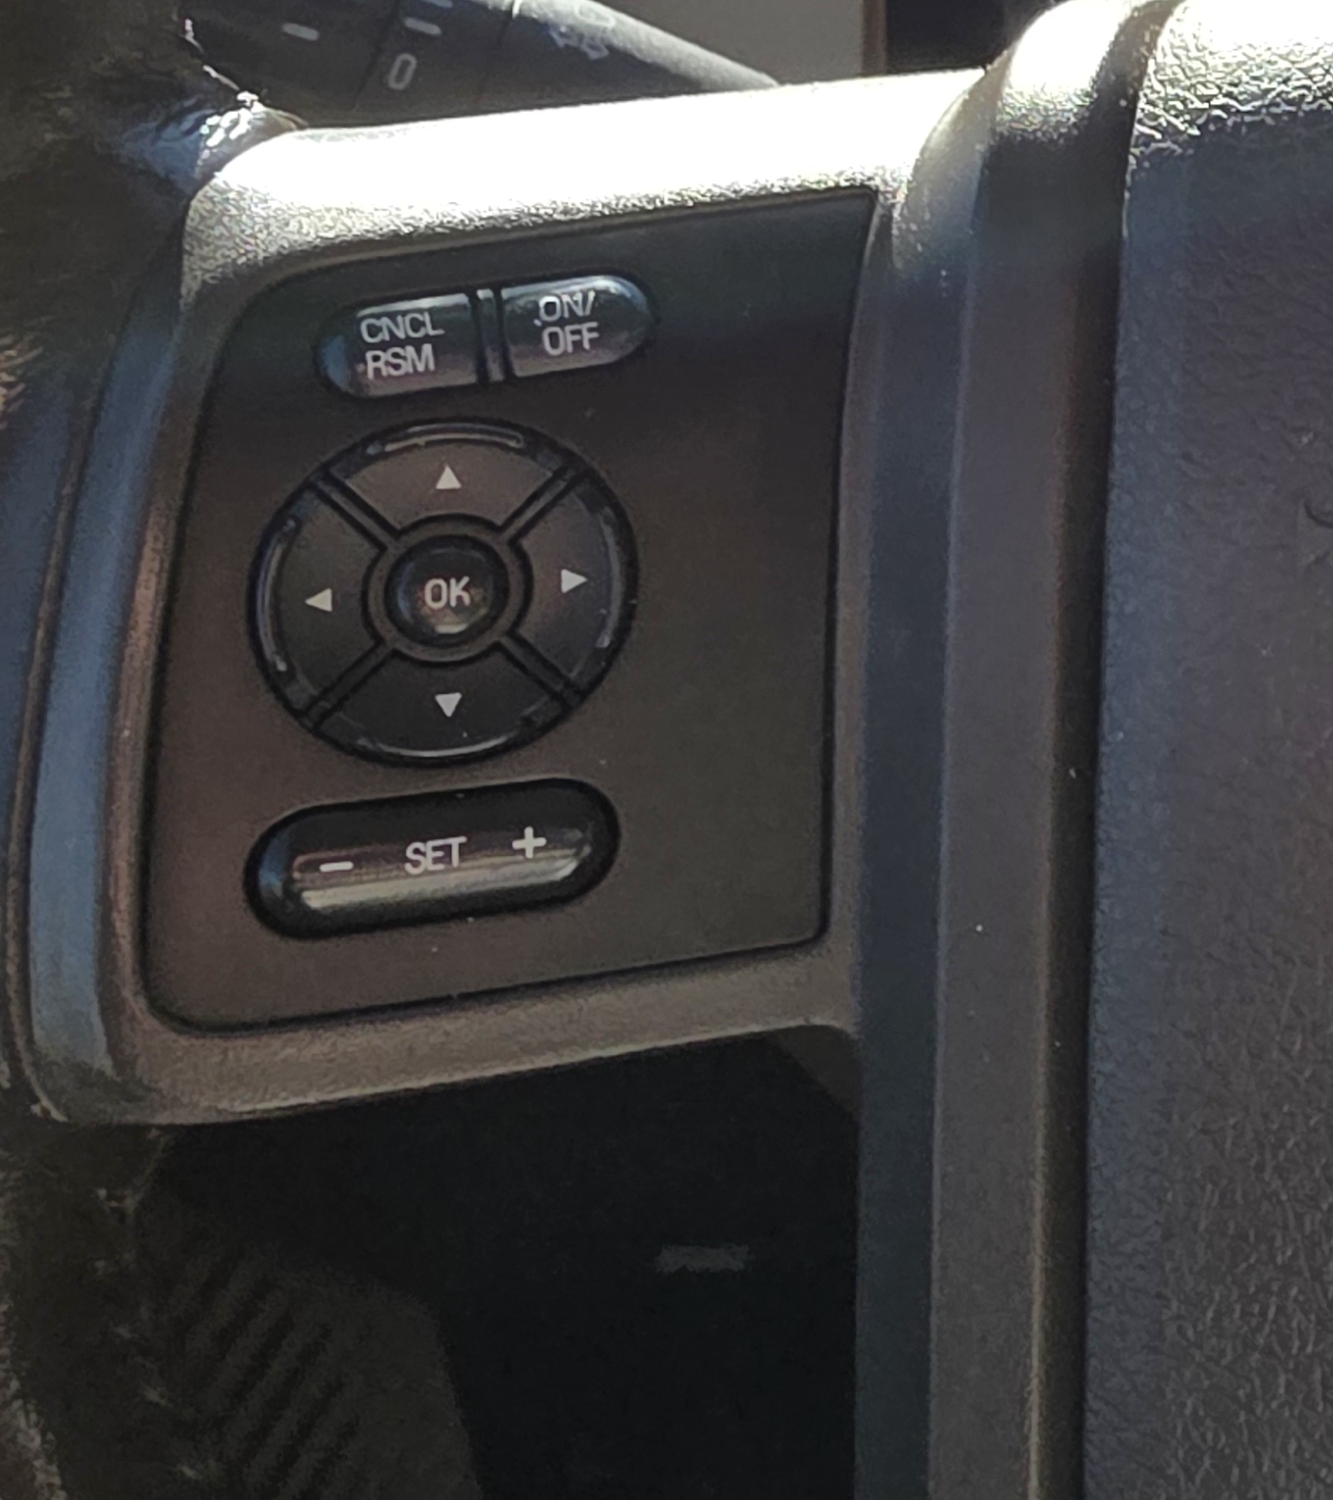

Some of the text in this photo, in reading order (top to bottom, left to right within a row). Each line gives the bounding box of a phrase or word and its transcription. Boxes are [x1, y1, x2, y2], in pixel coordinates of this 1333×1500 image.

[359, 310, 445, 343] CNCL
[541, 322, 600, 357] OFF
[364, 342, 436, 379] RSM
[423, 575, 472, 610] OK
[403, 834, 467, 876] SET
